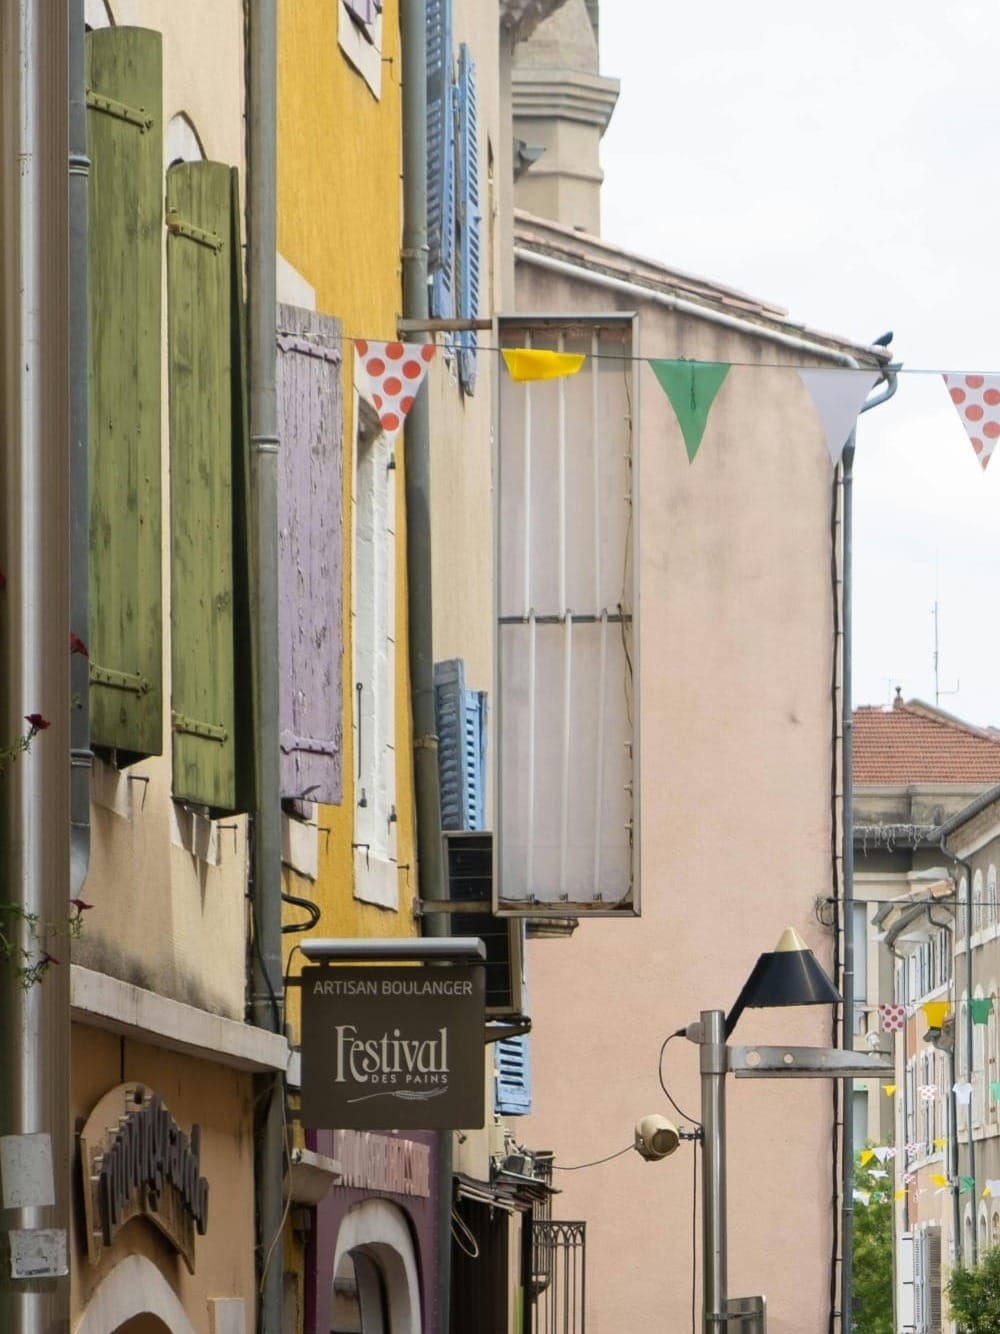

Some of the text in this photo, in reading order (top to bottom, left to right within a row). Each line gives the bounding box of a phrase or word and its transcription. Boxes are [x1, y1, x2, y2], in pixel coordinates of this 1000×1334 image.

[313, 980, 473, 995] ARTISAN BOULANGER
[334, 1024, 450, 1083] Festival
[371, 1074, 449, 1084] DES PAINS
